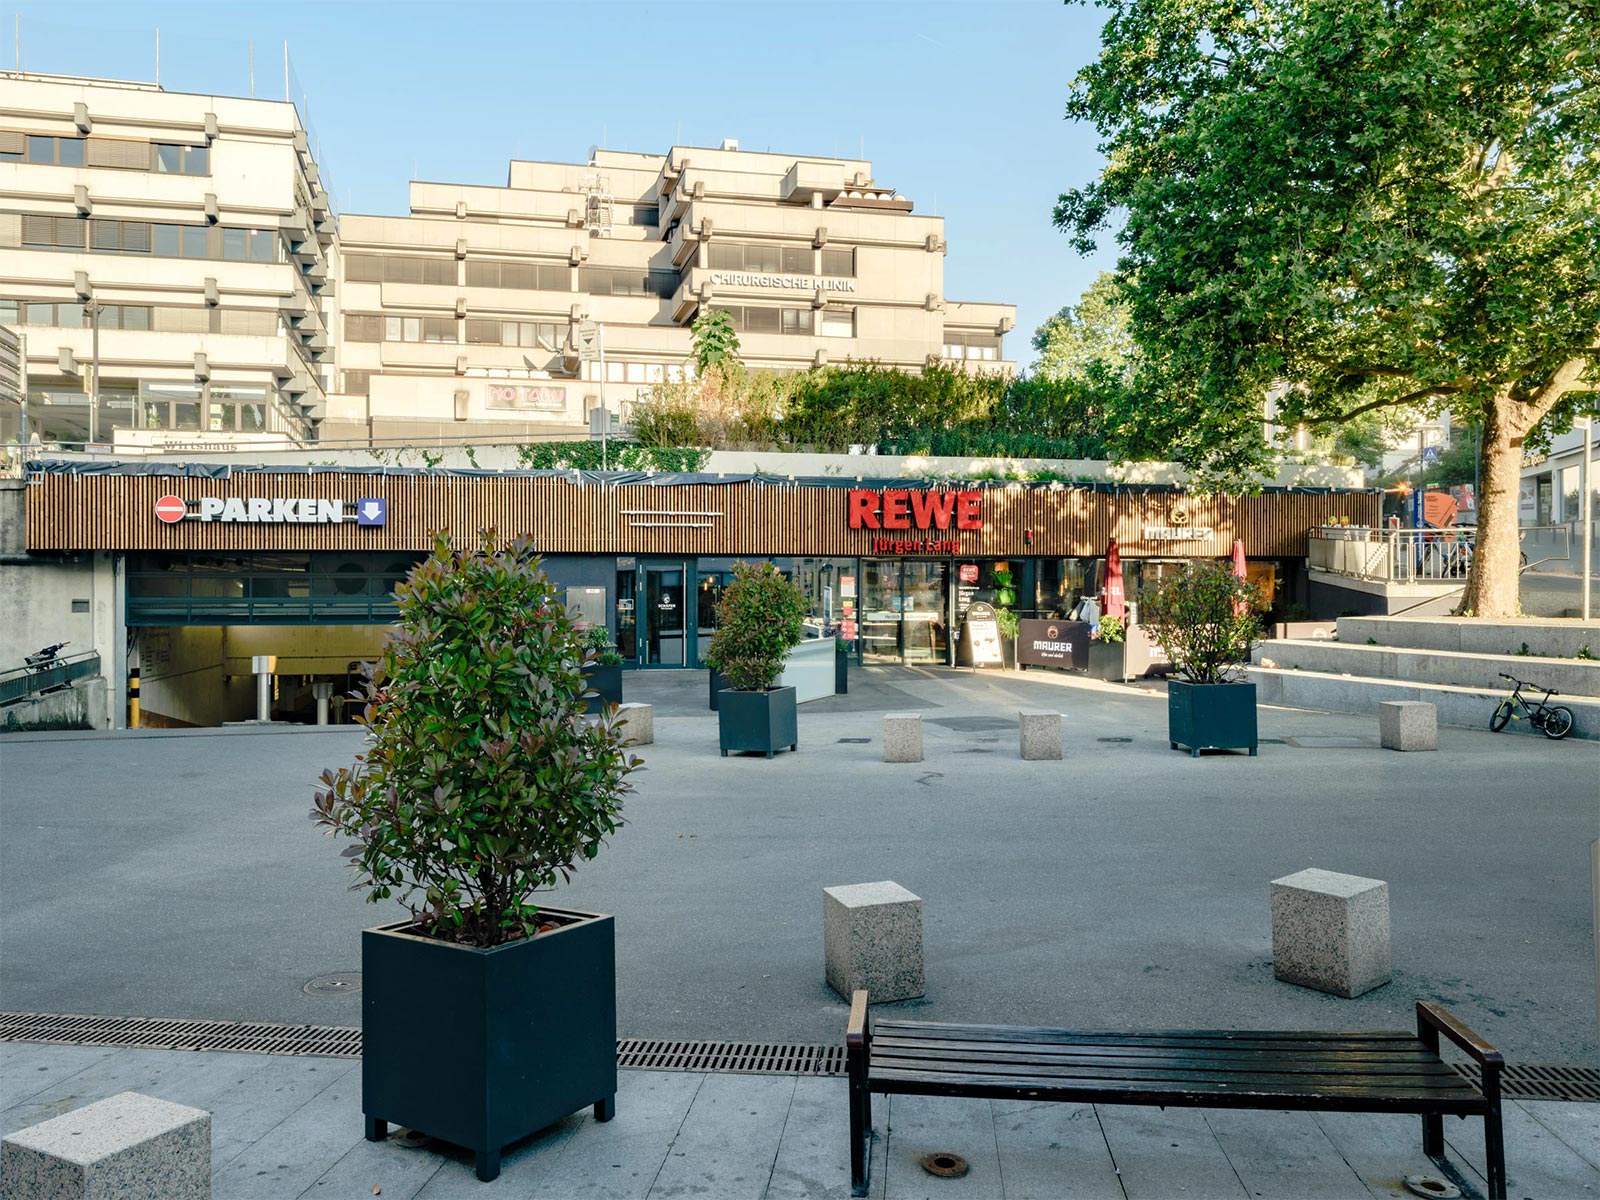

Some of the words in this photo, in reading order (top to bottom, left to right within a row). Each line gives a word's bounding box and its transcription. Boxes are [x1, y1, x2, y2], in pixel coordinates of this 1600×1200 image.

[710, 272, 809, 290] CHIRURGISCHE
[812, 279, 856, 292] KLINIK
[489, 386, 516, 401] NO
[520, 386, 565, 402] TABU
[163, 440, 237, 451] Wirtshaus
[201, 497, 343, 523] PARKEN
[849, 489, 984, 530] REWE
[1144, 526, 1215, 541] MAURER
[873, 536, 922, 555] Jürgen
[925, 536, 961, 555] Lang
[1033, 640, 1073, 653] MAURER
